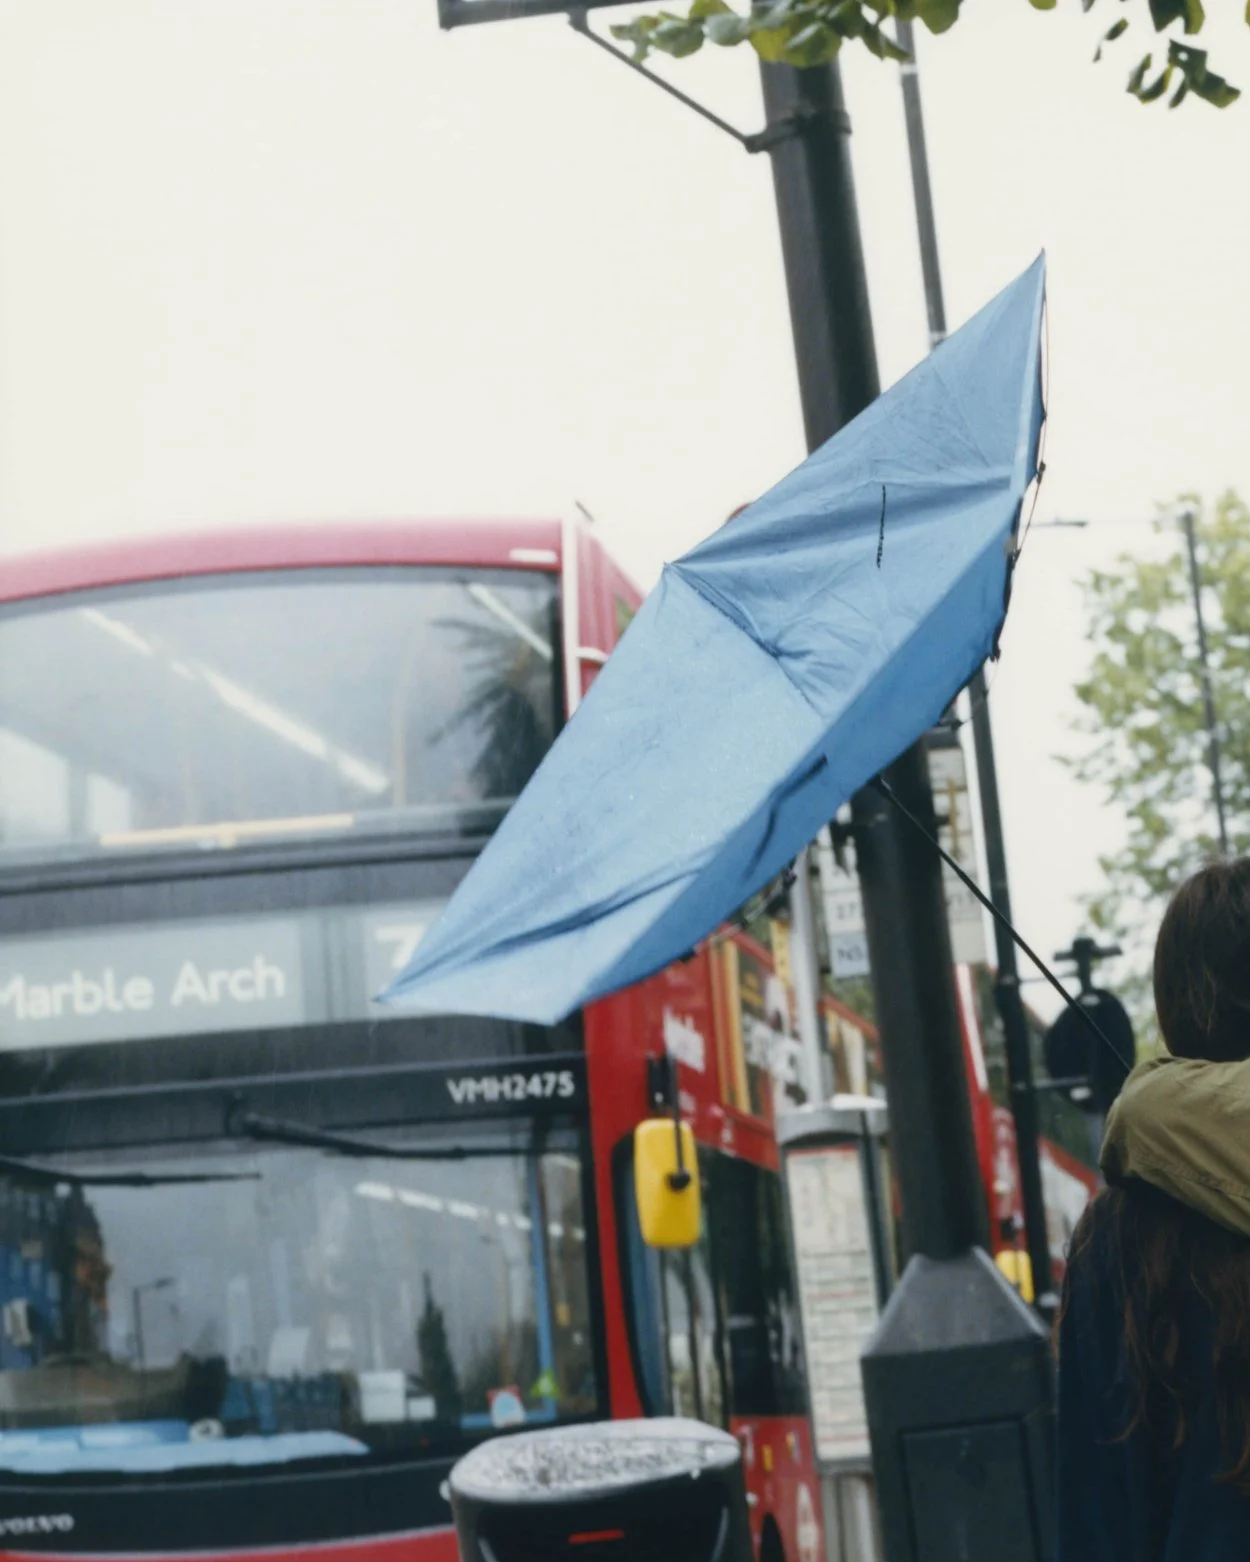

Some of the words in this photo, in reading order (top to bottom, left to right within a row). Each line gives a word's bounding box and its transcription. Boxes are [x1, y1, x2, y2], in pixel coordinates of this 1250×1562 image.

[0, 966, 154, 1019] Marble
[170, 953, 285, 1007] Arch
[446, 1070, 575, 1104] VMH2475
